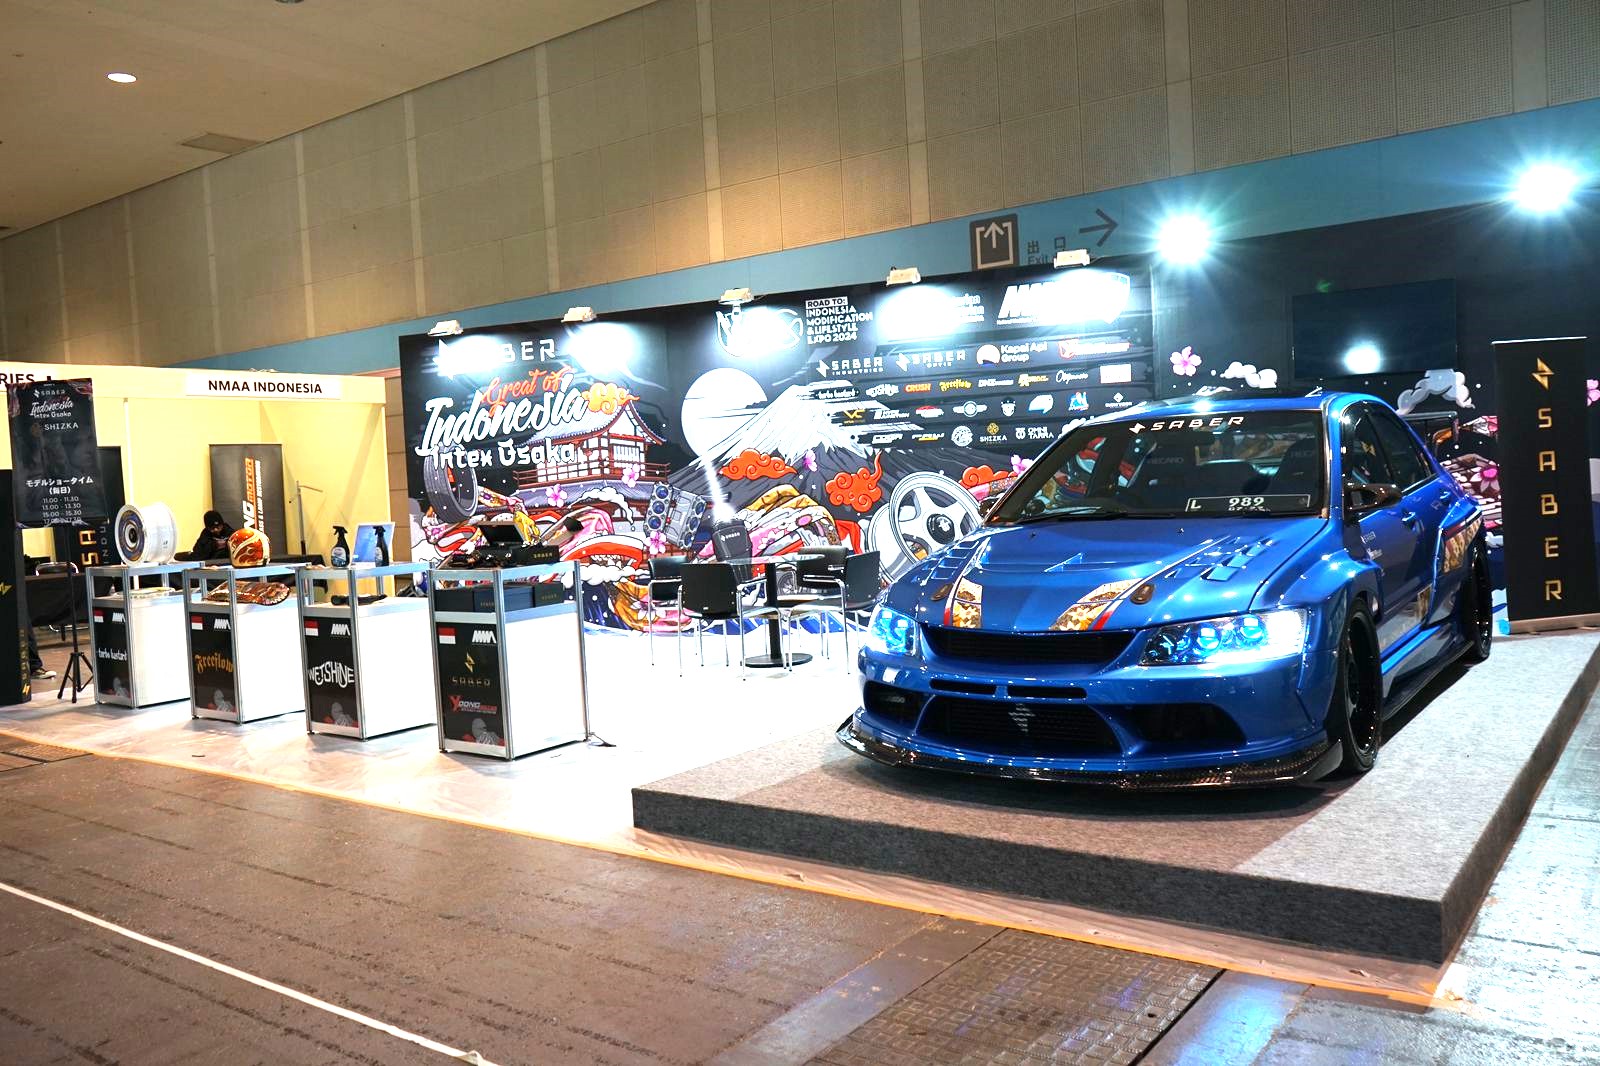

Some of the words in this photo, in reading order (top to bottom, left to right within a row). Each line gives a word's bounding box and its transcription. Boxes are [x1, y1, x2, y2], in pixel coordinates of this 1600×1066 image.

[808, 299, 831, 308] ROAD
[806, 305, 857, 318] INDONESIA
[807, 311, 874, 326] MODIFICATION
[833, 331, 857, 342] 2024
[831, 356, 883, 371] SABER
[912, 350, 967, 366] SABER
[1001, 353, 1030, 363] Group
[208, 381, 250, 393] NMAA
[254, 382, 323, 395] INDONESIA
[415, 373, 590, 457] Indonesia
[44, 421, 80, 433] SHIZKA
[1151, 416, 1246, 430] SABER
[26, 476, 94, 488] モデルショータイム
[1229, 497, 1265, 507] 989
[1538, 408, 1562, 601] SABER
